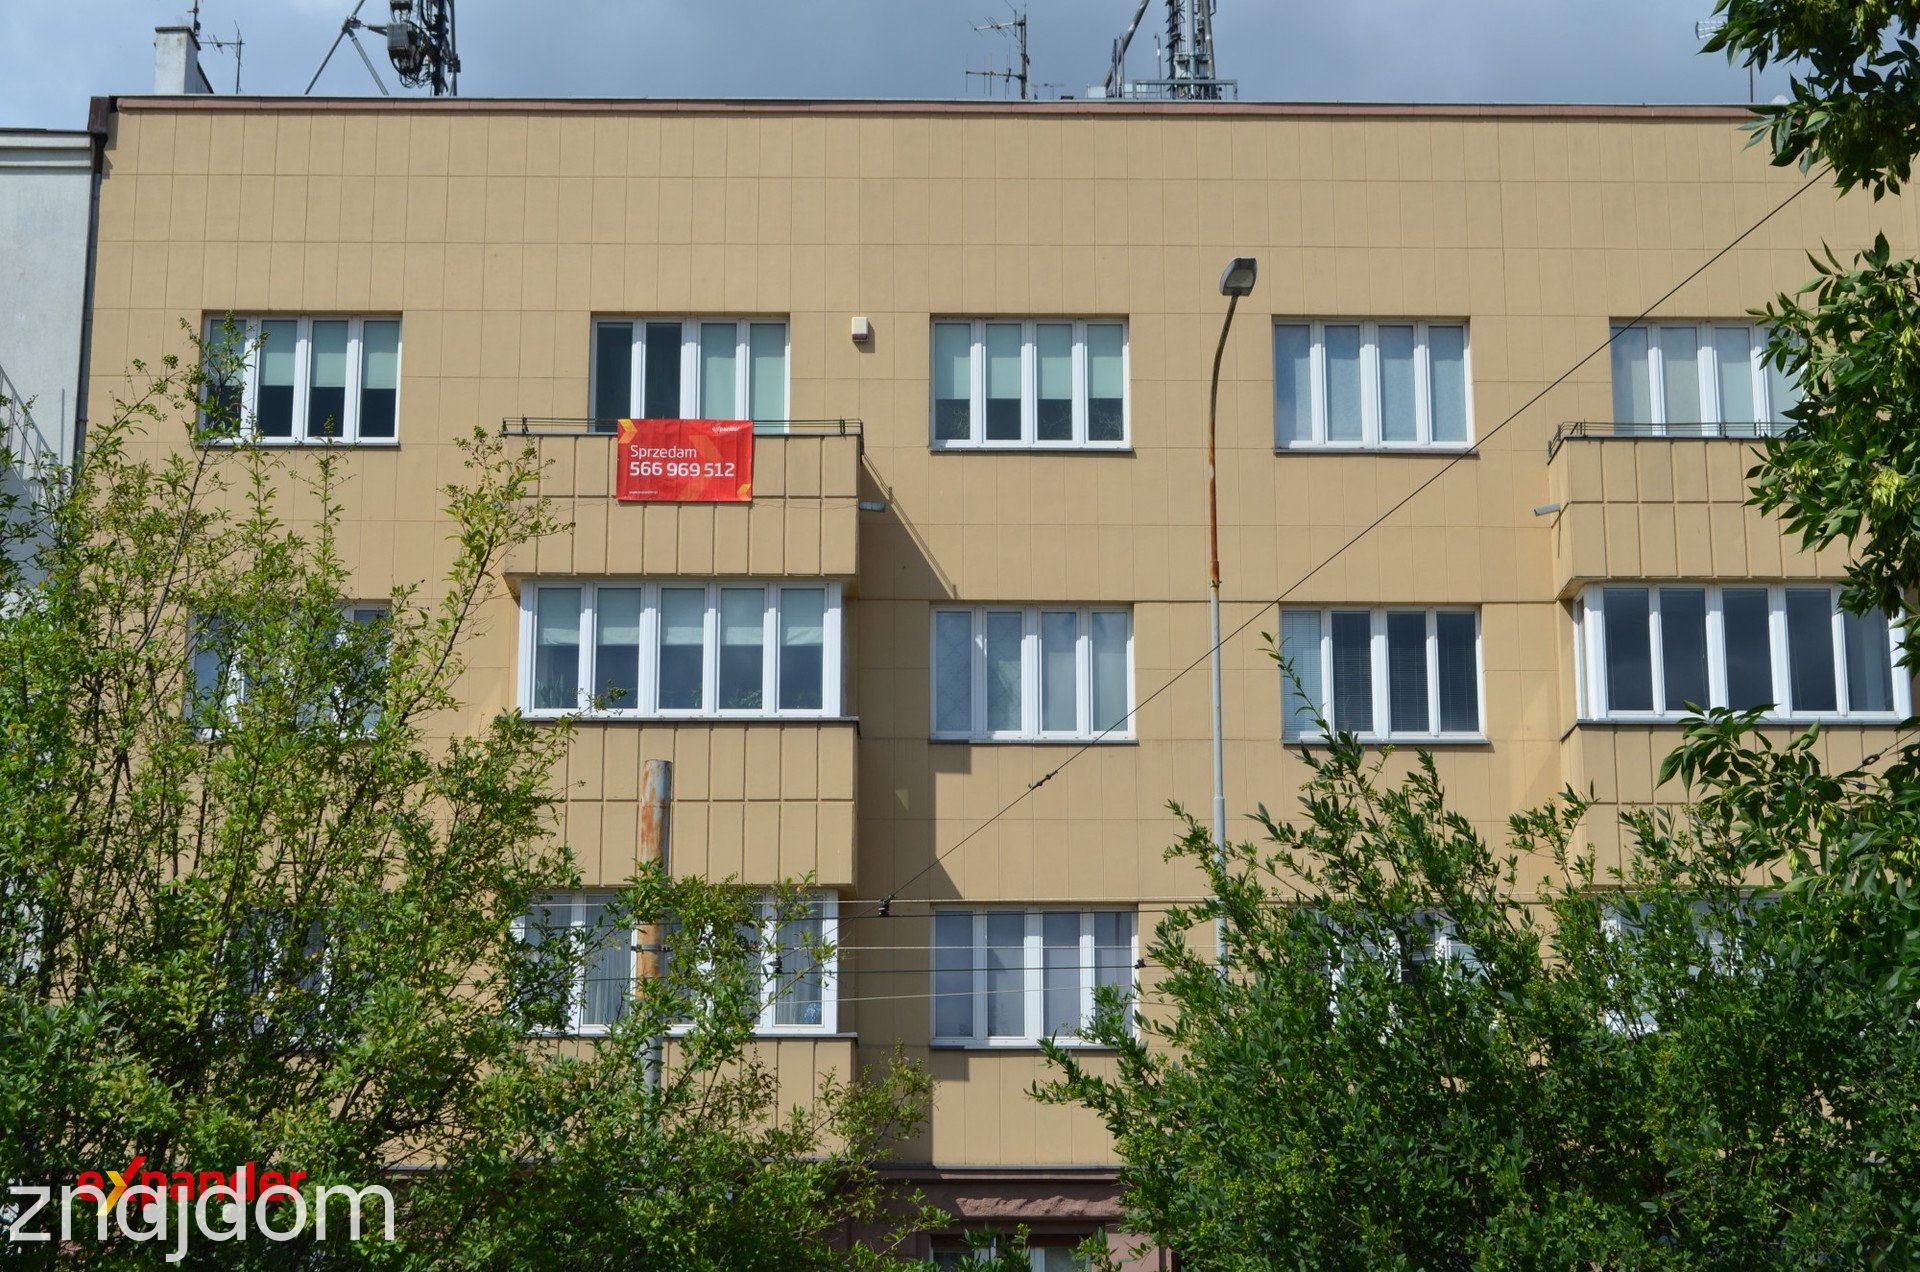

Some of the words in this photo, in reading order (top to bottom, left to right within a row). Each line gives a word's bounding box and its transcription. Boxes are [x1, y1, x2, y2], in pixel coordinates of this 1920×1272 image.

[630, 445, 697, 459] Sprzedam
[630, 461, 663, 476] 566
[666, 462, 700, 477] 969
[704, 462, 735, 477] 512
